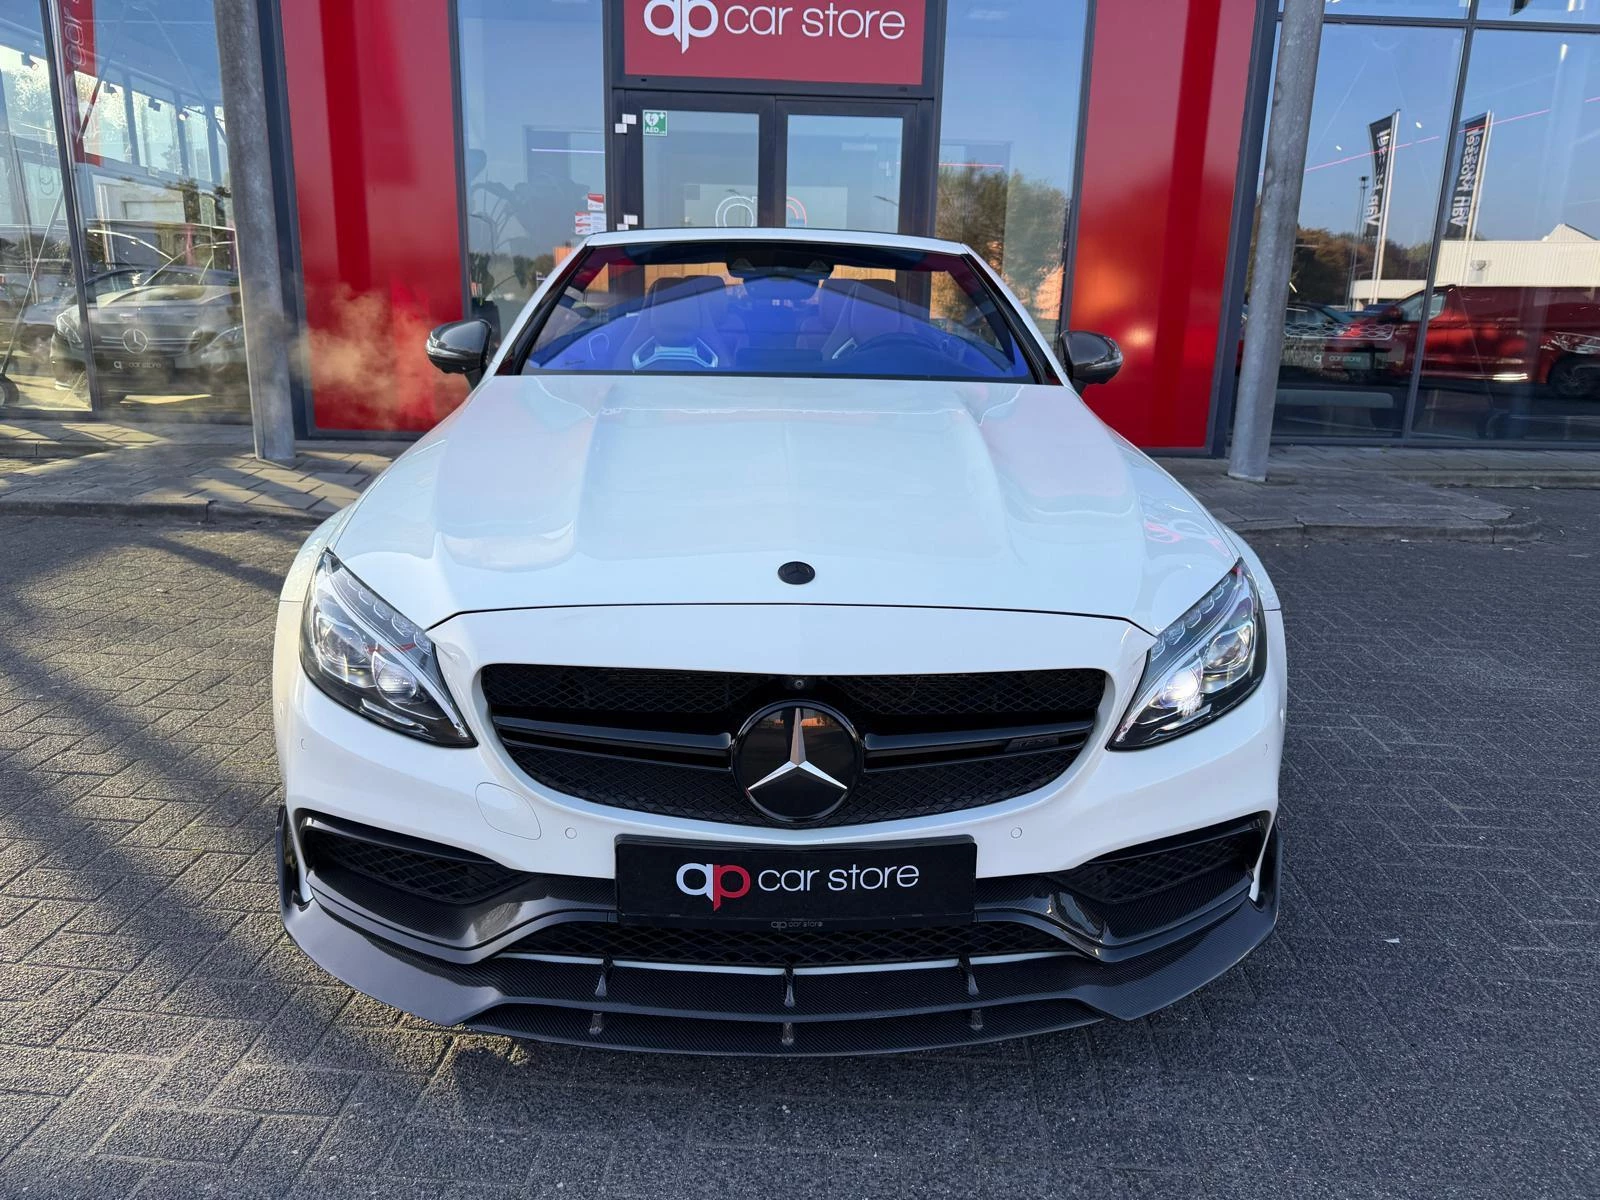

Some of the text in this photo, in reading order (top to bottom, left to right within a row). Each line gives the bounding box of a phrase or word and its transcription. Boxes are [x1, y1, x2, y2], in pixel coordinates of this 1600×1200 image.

[643, 0, 906, 54] ap car store
[675, 862, 920, 912] ap car store
